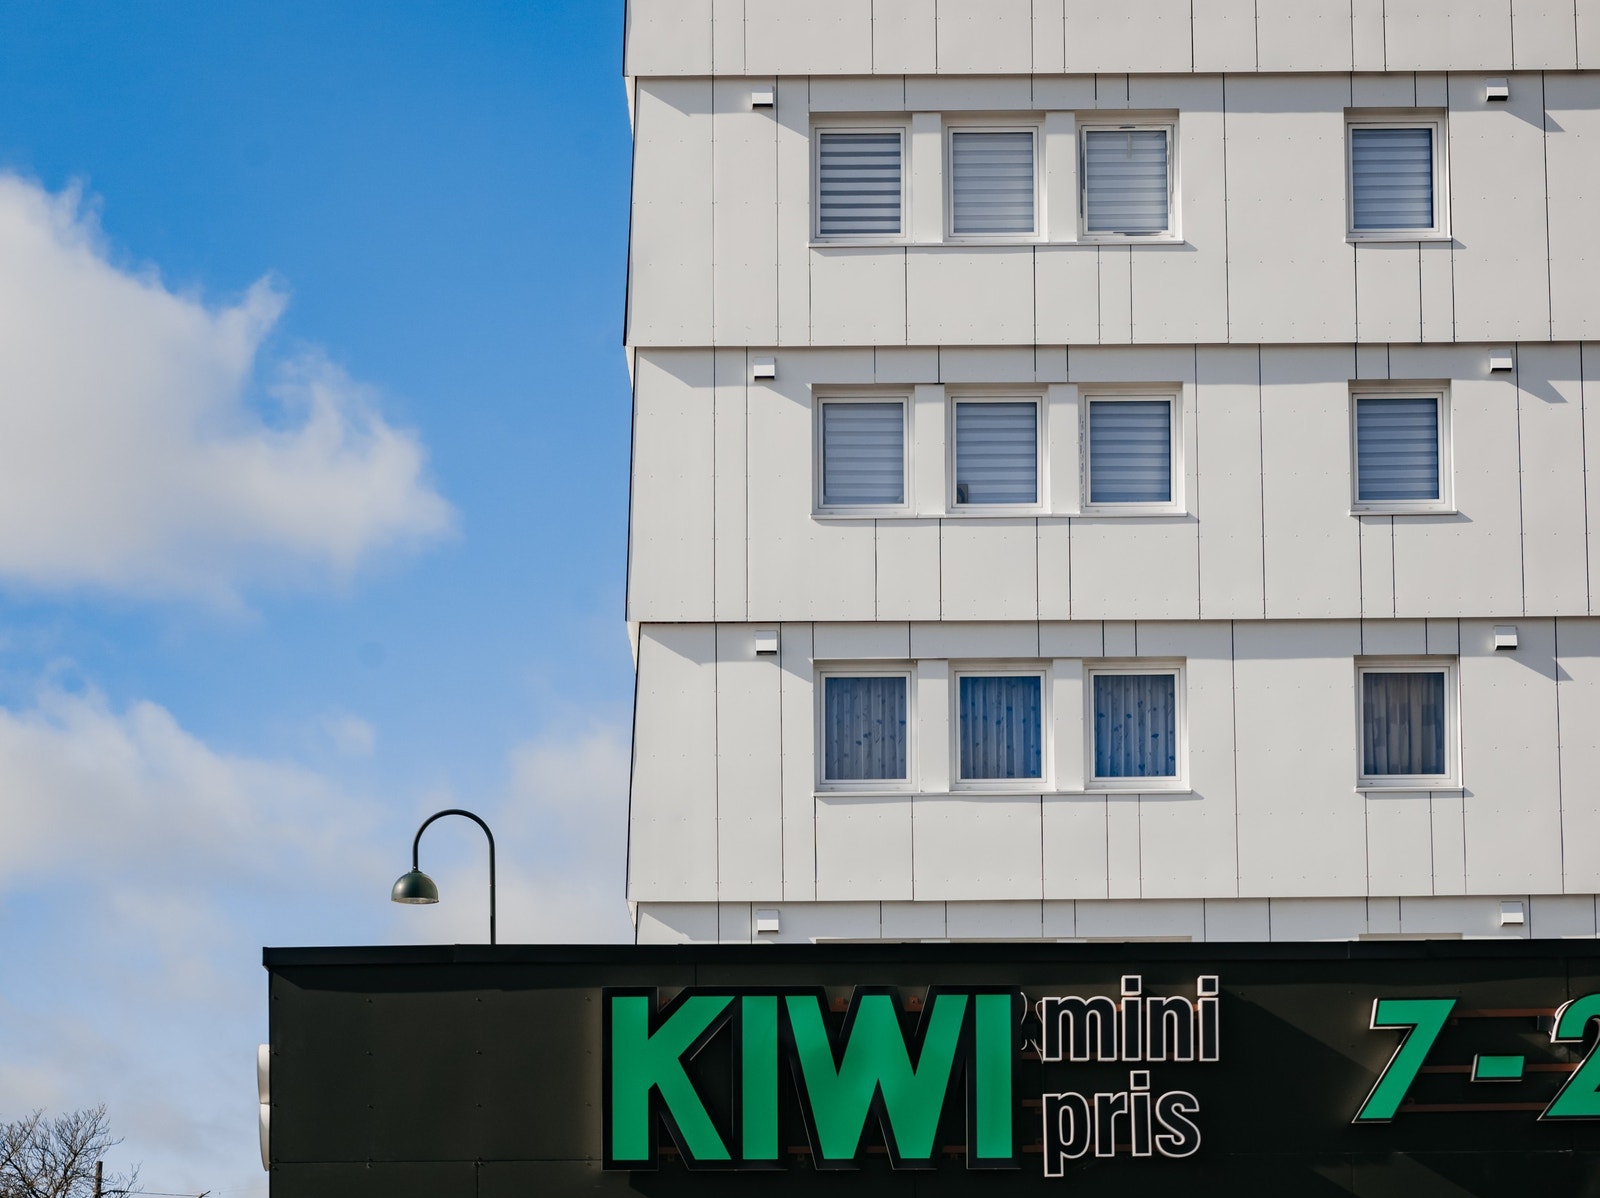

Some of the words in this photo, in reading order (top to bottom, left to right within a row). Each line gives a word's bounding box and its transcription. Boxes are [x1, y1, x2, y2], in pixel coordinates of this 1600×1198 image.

[1042, 975, 1219, 1061] mini
[603, 985, 1019, 1169] KIWI
[1043, 1070, 1201, 1177] pris
